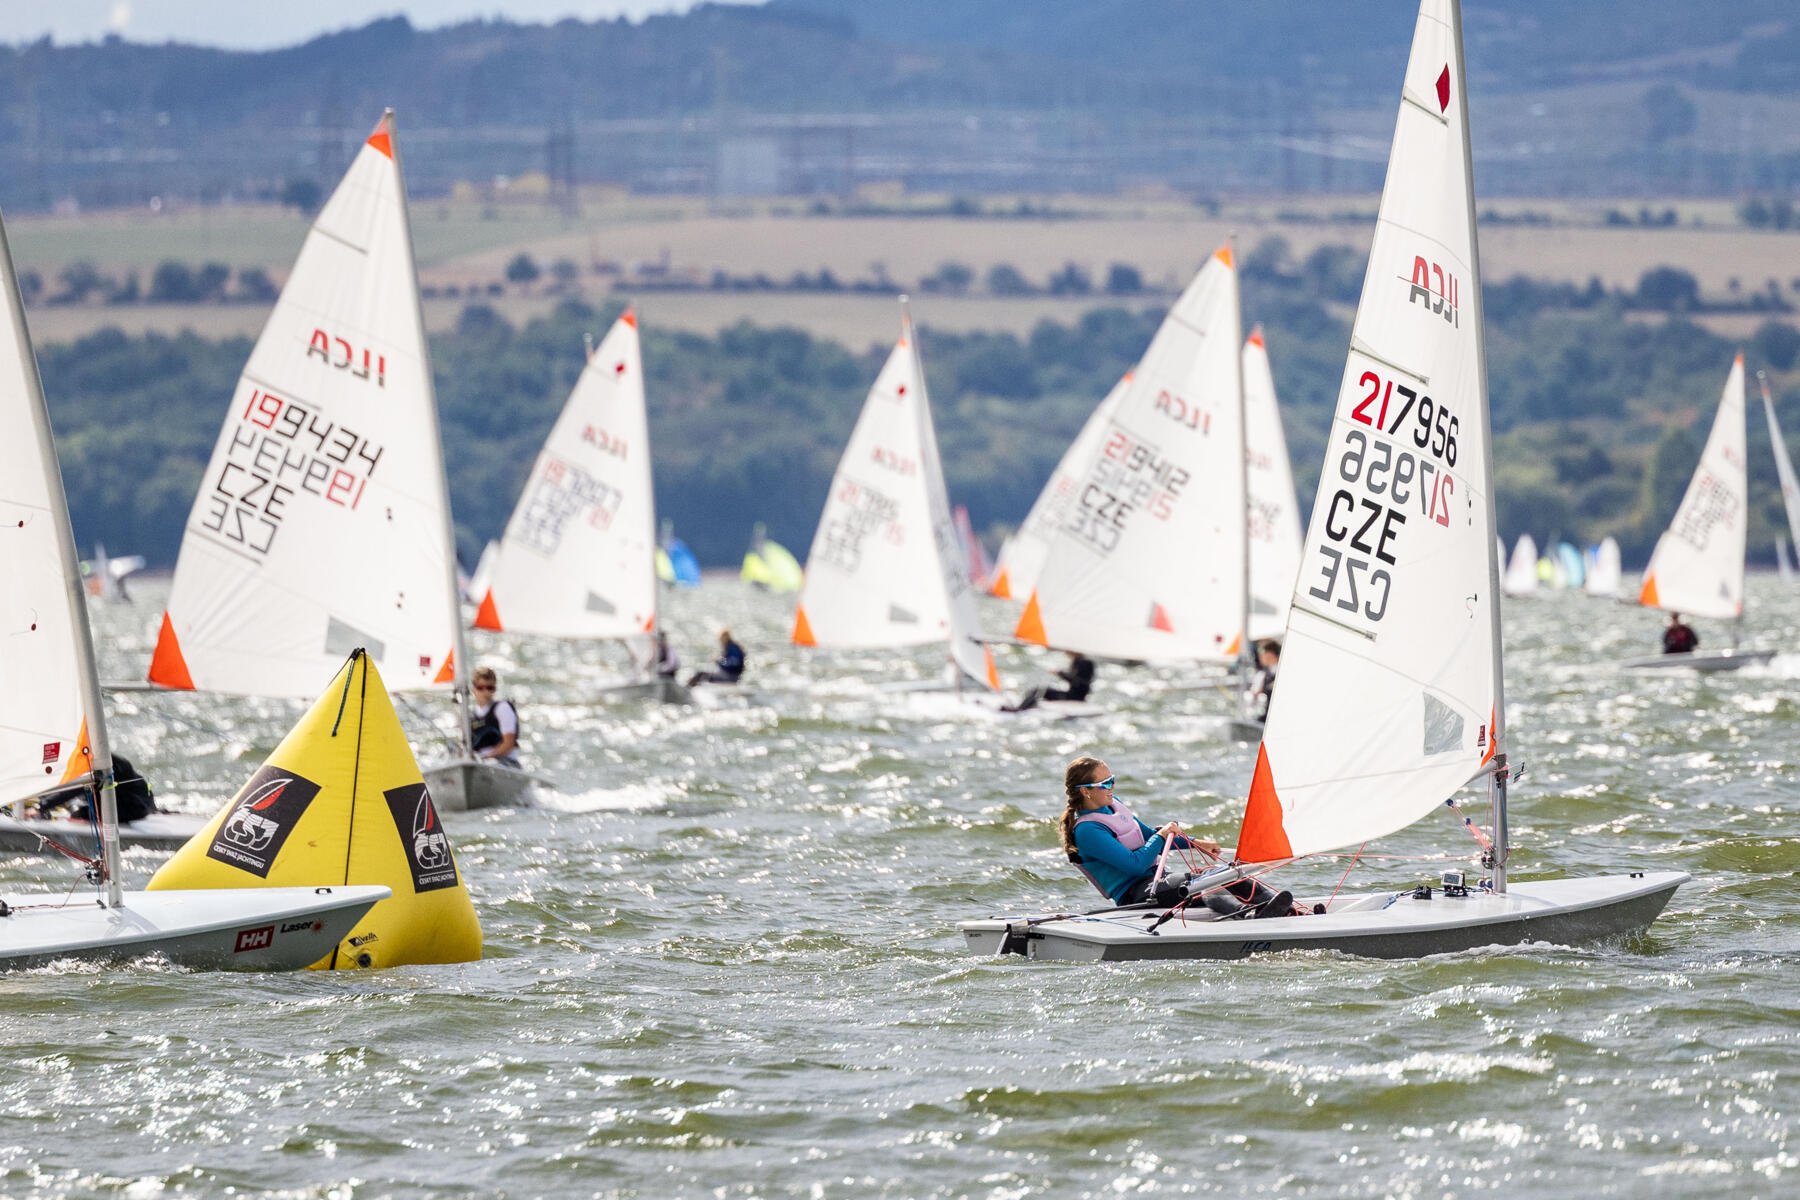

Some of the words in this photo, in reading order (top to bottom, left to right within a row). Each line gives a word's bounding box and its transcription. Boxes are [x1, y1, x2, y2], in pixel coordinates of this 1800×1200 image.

[243, 389, 384, 477] 199434
[1351, 371, 1459, 468] 217956
[217, 462, 295, 521] CZE
[1080, 482, 1135, 530] CZE
[1325, 489, 1407, 566] CZE
[280, 921, 314, 934] Laser
